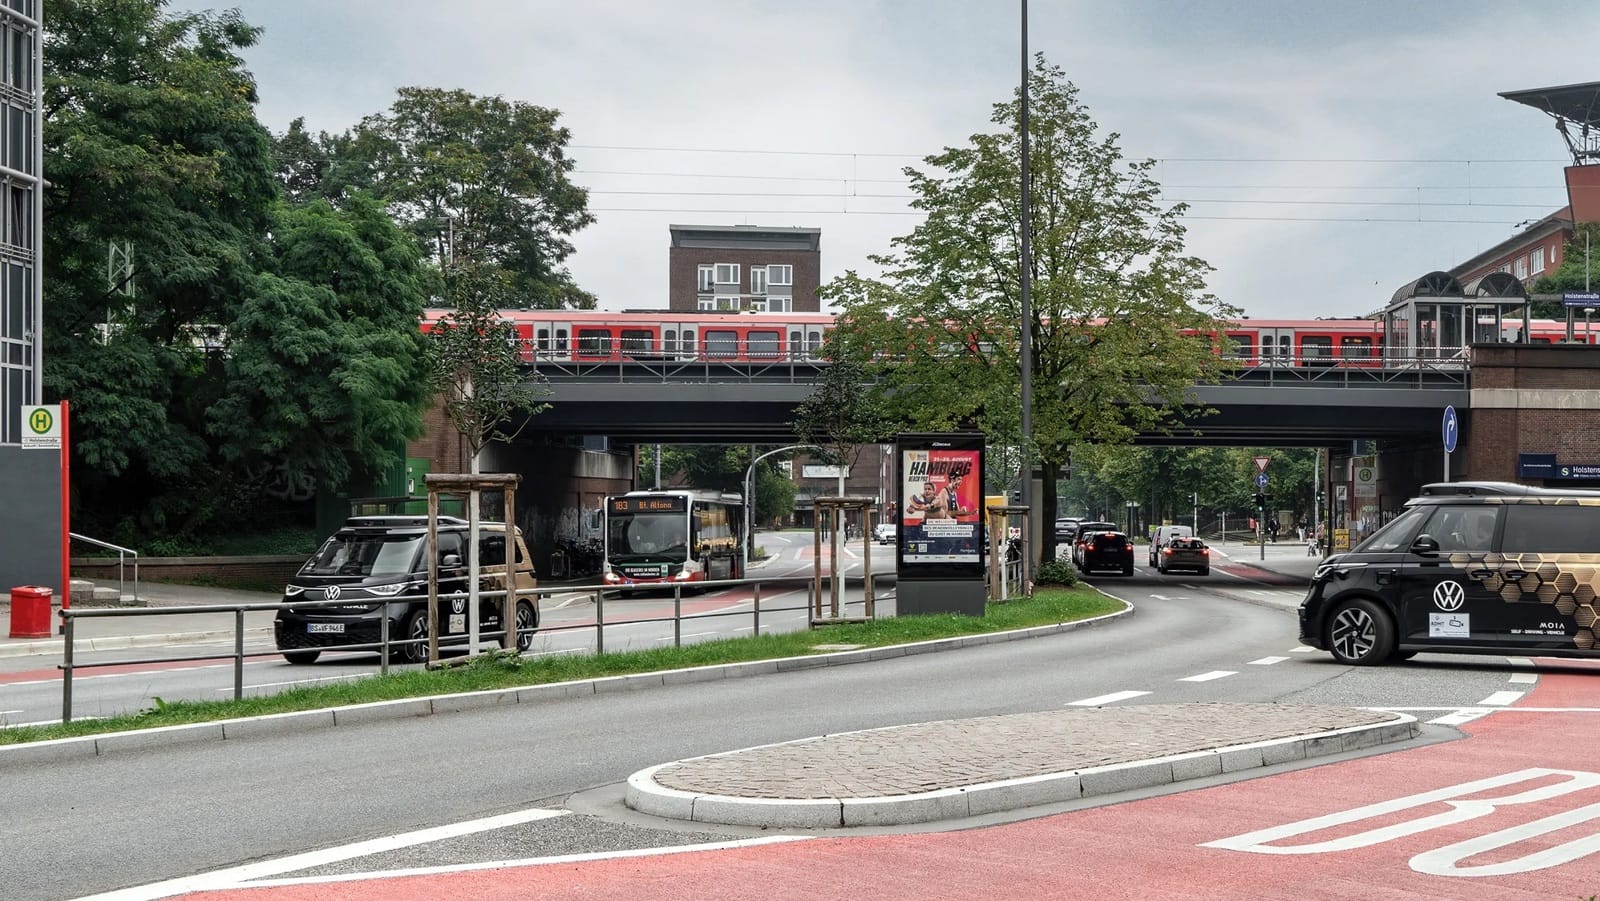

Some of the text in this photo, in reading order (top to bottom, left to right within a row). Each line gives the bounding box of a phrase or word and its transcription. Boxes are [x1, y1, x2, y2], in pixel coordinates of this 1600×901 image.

[36, 414, 46, 429] H
[910, 461, 972, 476] HAMBURG
[1561, 467, 1570, 477] S
[614, 501, 628, 510] 183
[650, 501, 672, 510] Altona
